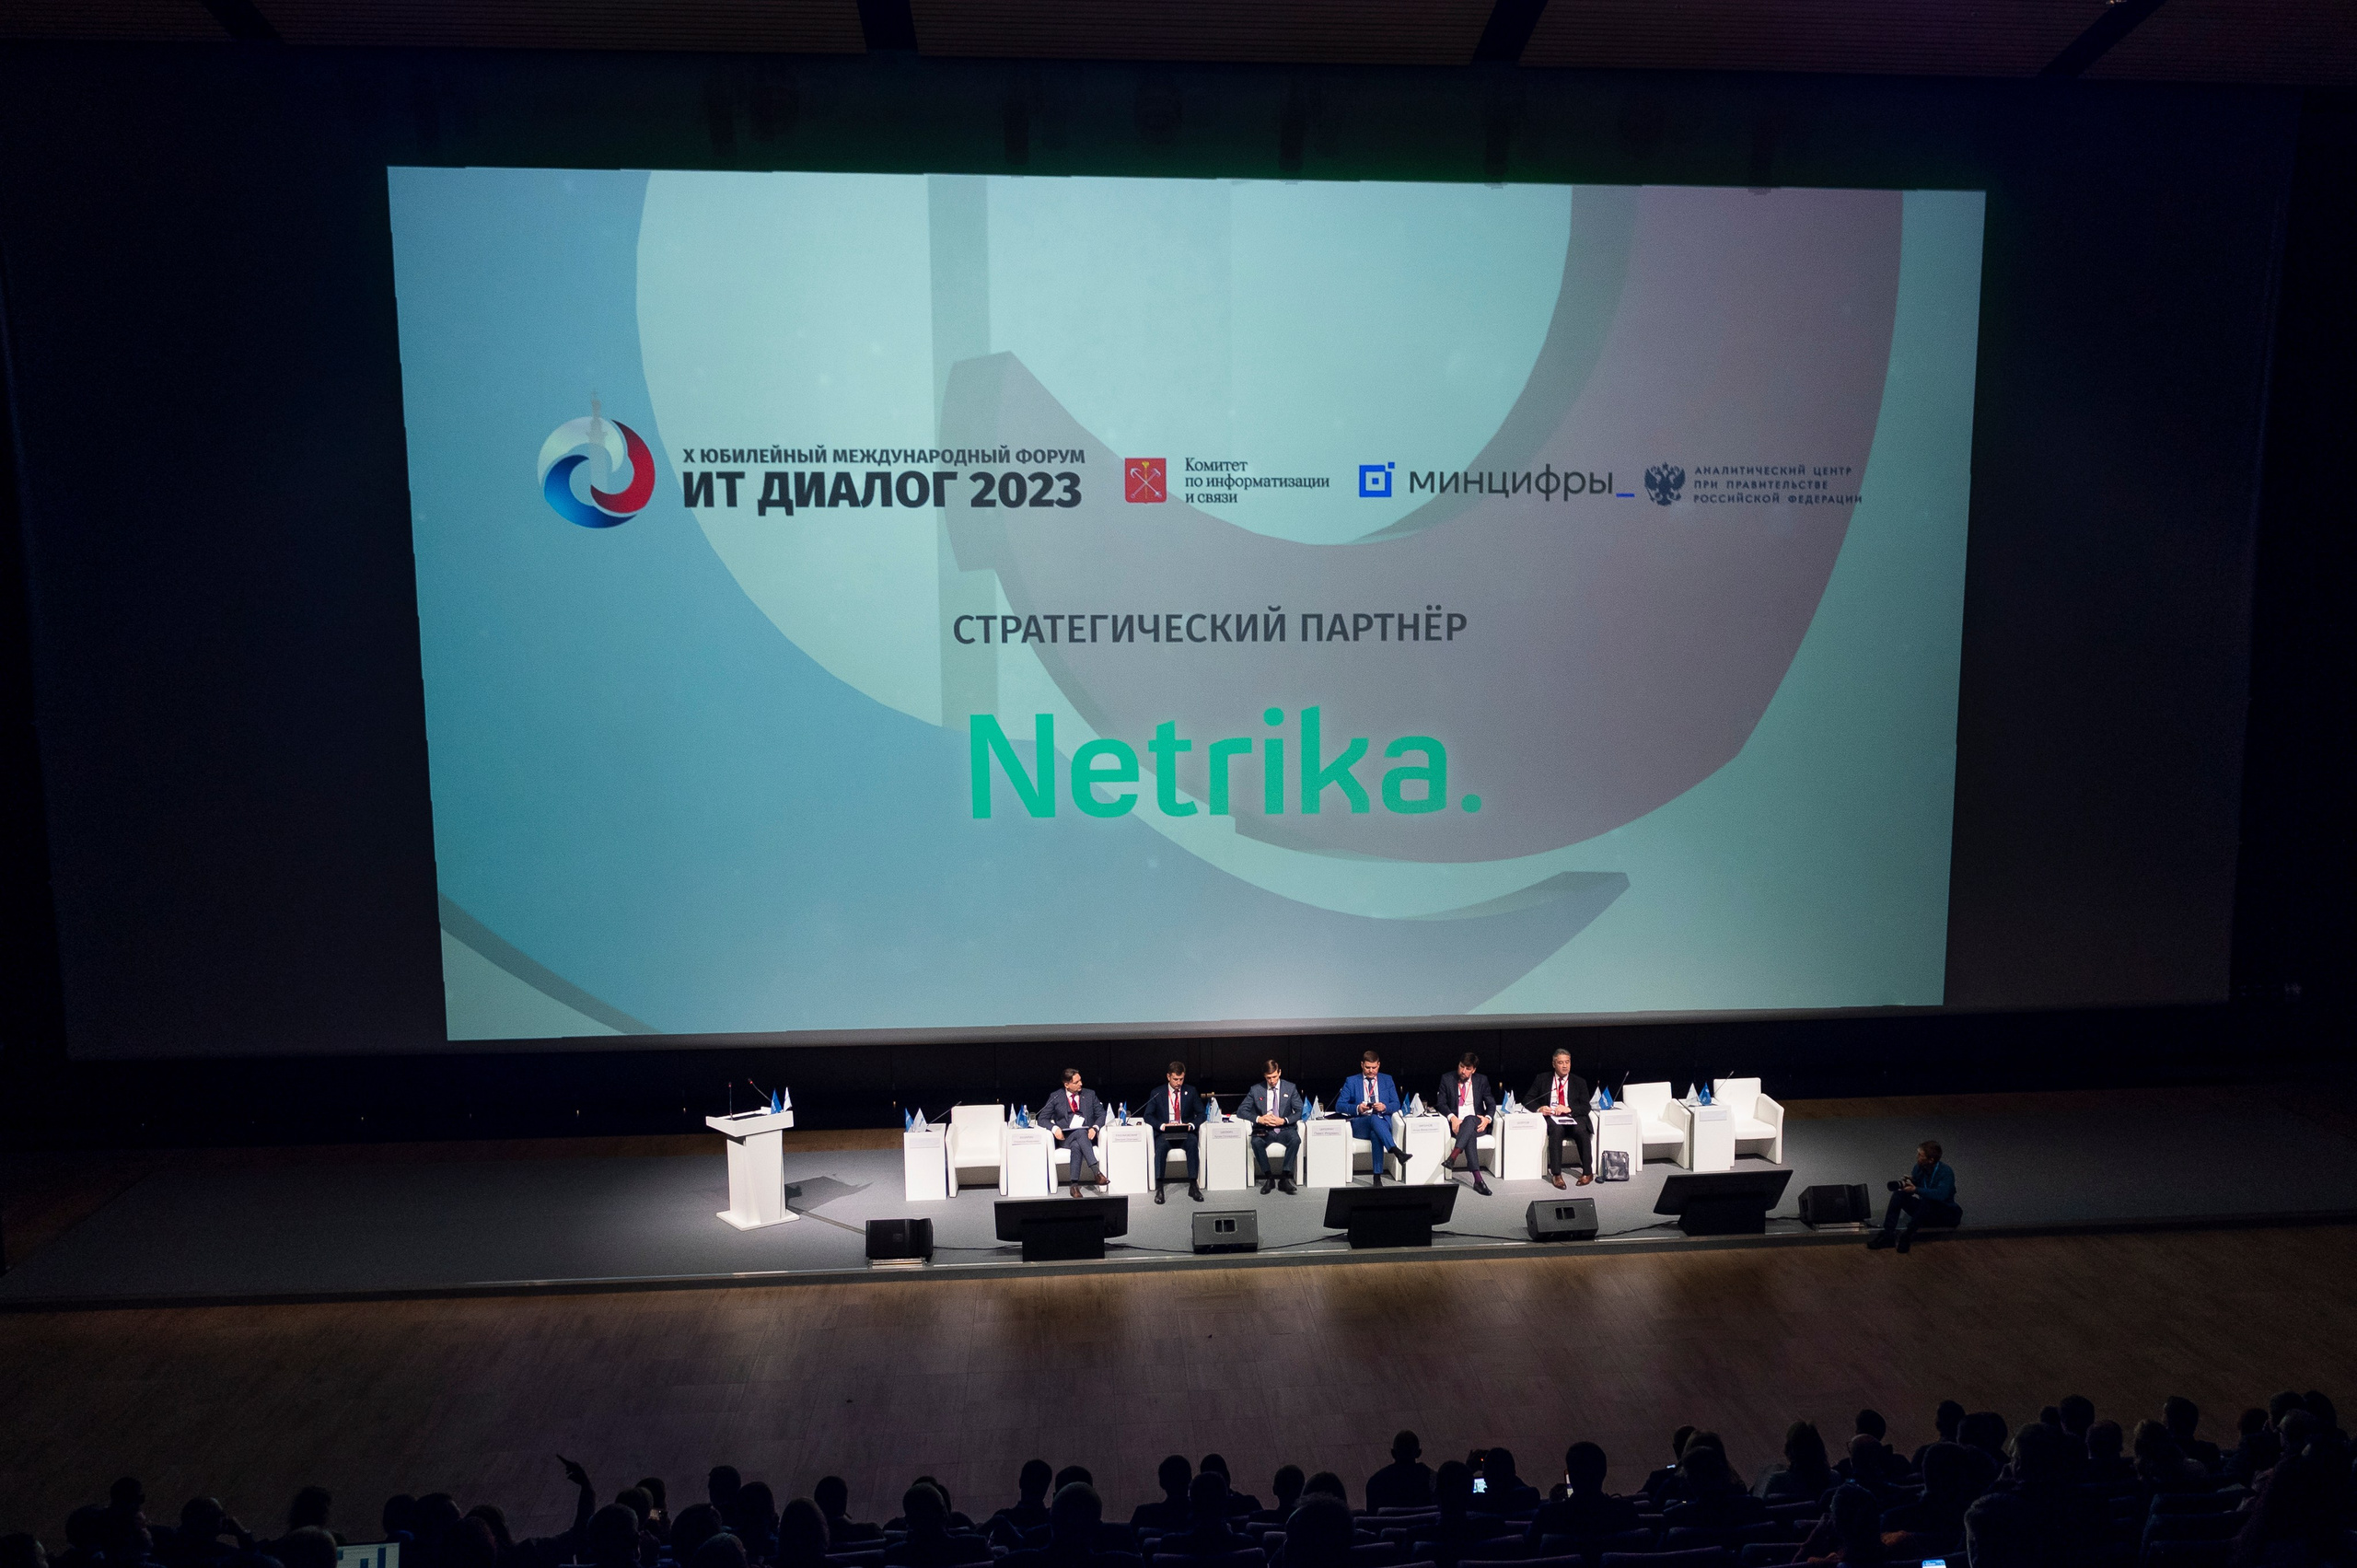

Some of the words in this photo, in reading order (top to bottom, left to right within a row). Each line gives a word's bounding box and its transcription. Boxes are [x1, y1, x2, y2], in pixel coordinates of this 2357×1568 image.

[700, 446, 827, 463] ЮБИЛЕЙНЫЙ
[832, 446, 1011, 465] МЕЖДУНАРОДНЫЙ
[1016, 448, 1086, 464] ФОРУМ
[1185, 458, 1248, 471] Комитет
[1694, 465, 1805, 476] АНАЛИТИЧЕСКИЙ
[1813, 467, 1852, 476] ЦЕНТР
[1185, 476, 1202, 487] по
[1206, 473, 1330, 490] информатизации
[1694, 480, 1718, 490] ПРИ
[1726, 480, 1829, 490] ПРАВИТЕЛЬСТВЕ
[682, 471, 745, 507] ИТ
[757, 471, 958, 516] ДИАЛОГ
[970, 471, 1082, 507] 2023
[1185, 493, 1194, 503] и
[1197, 493, 1238, 503] связи
[1693, 493, 1780, 505] РОССИЙСКОЙ
[1788, 494, 1863, 505] ФЕДЕРАЦИИ
[953, 606, 1287, 645] СТРАТЕГИЧЕСКИЙ
[1301, 606, 1468, 642] ПАРТНЁР
[970, 705, 1482, 819] Netrika.
